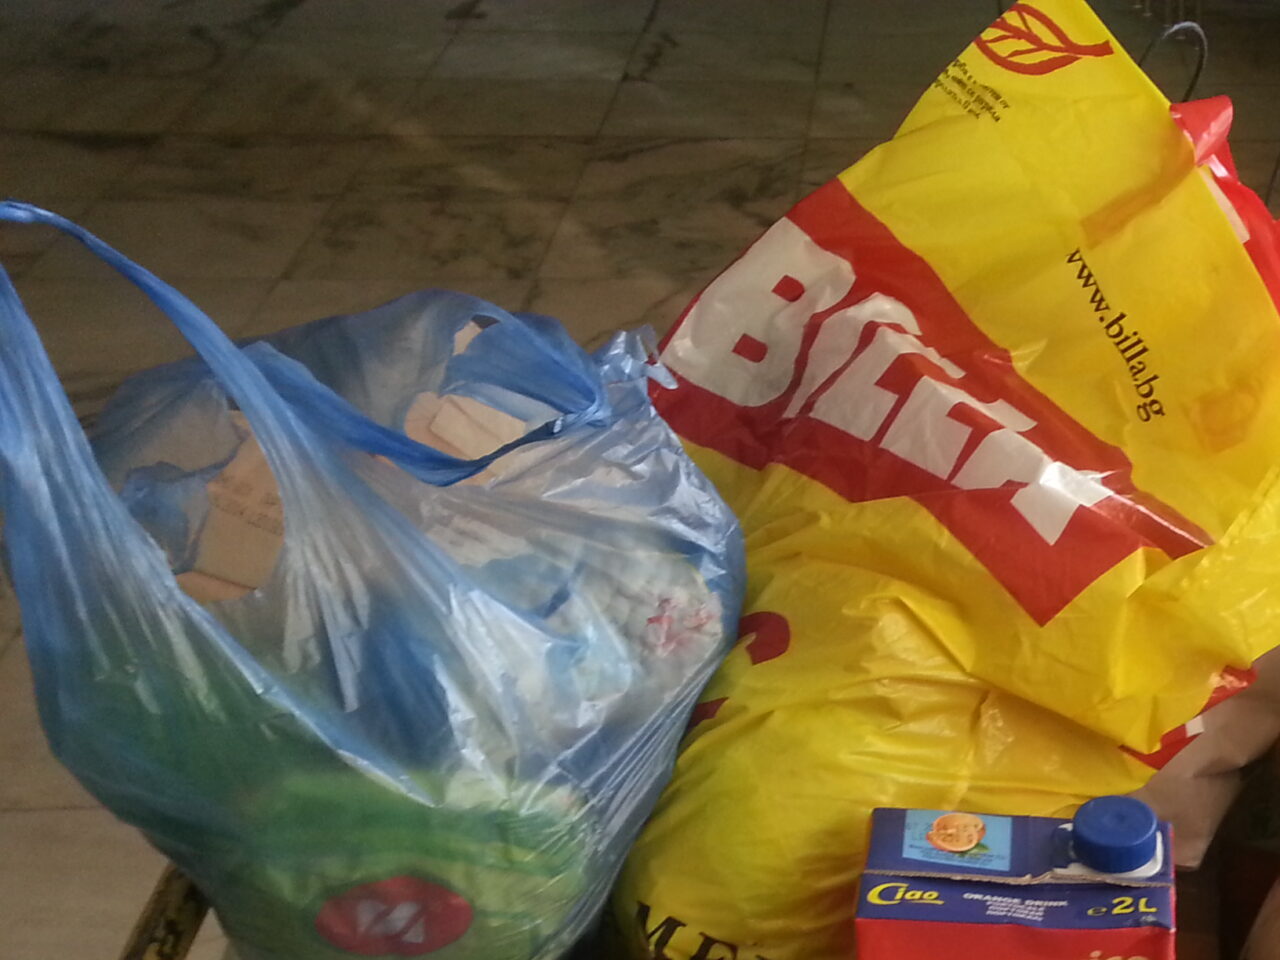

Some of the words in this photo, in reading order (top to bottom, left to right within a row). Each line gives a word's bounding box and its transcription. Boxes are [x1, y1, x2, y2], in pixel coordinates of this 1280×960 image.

[657, 216, 1116, 546] BILLA
[866, 882, 945, 905] Ciao
[1111, 896, 1158, 915] 2L
